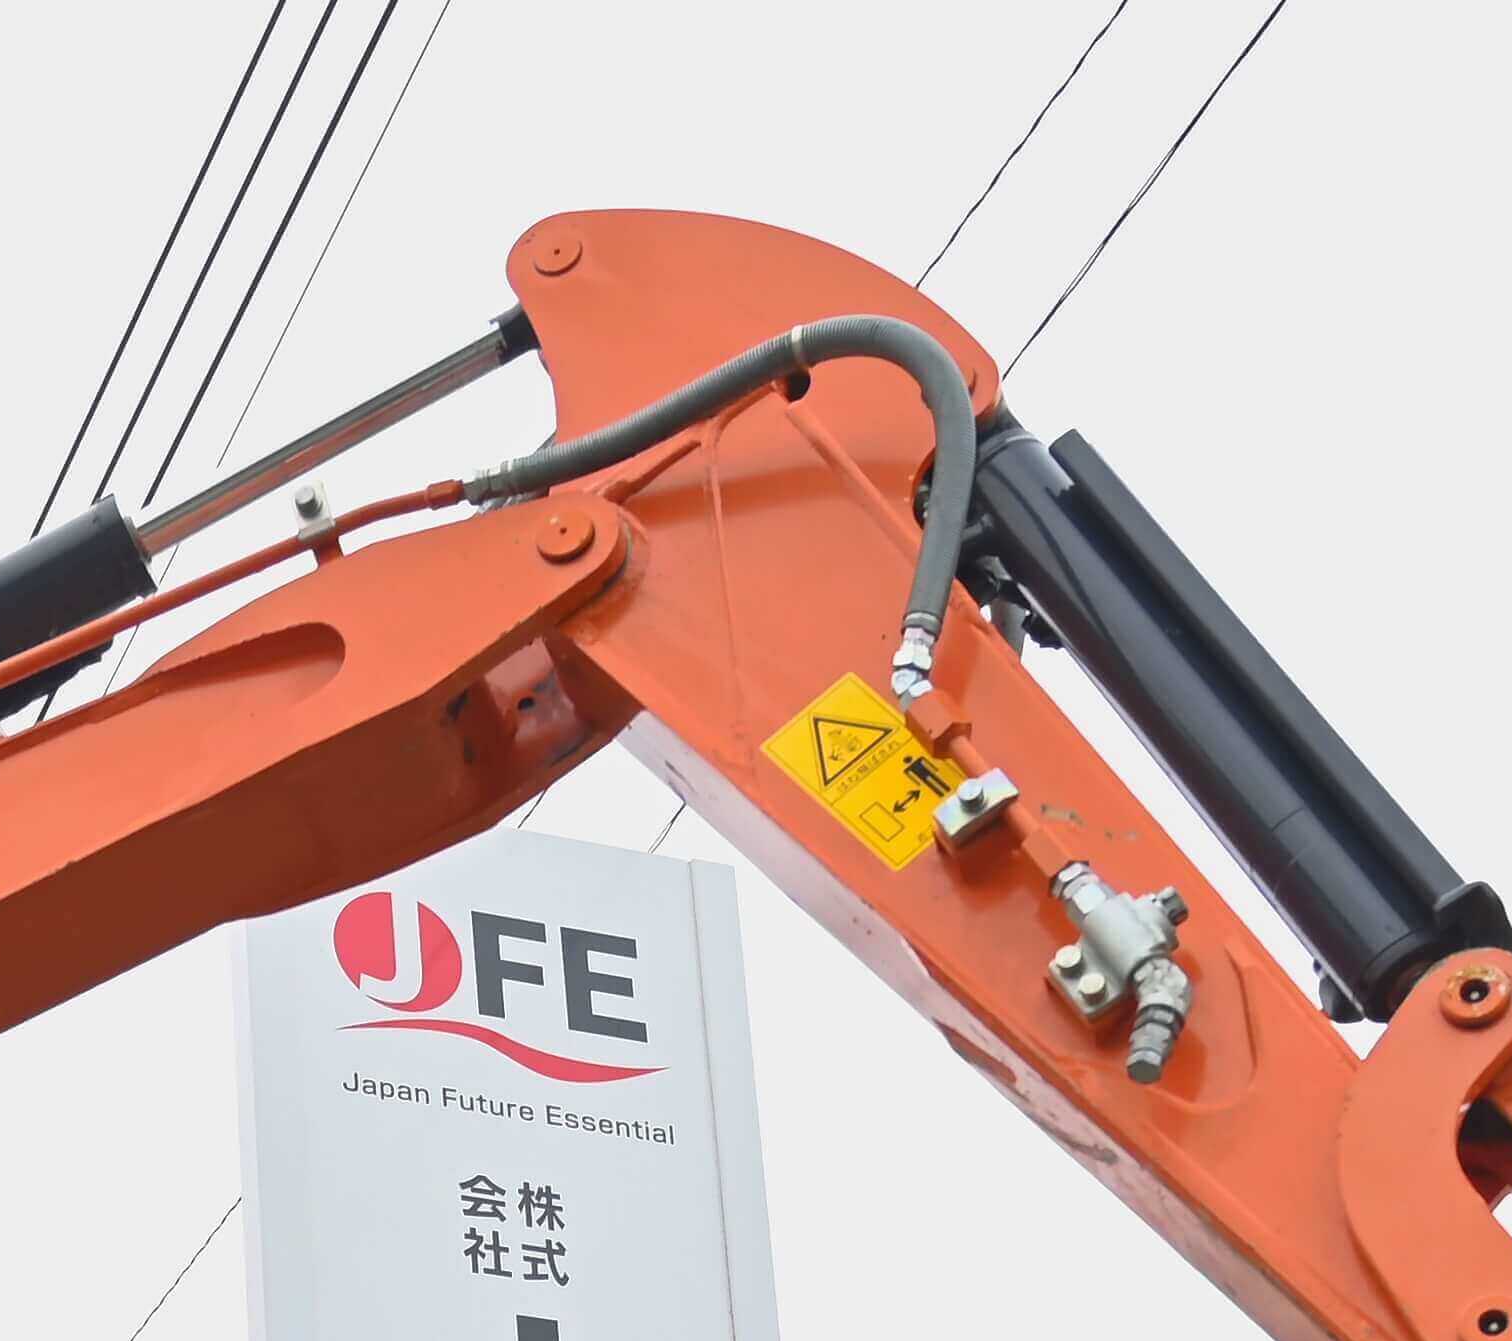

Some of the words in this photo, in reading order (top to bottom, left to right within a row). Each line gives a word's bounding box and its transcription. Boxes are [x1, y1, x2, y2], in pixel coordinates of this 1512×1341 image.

[334, 891, 648, 1043] JFE
[342, 1071, 431, 1106] Japan
[441, 1087, 536, 1122] Future
[545, 1104, 676, 1147] Essential
